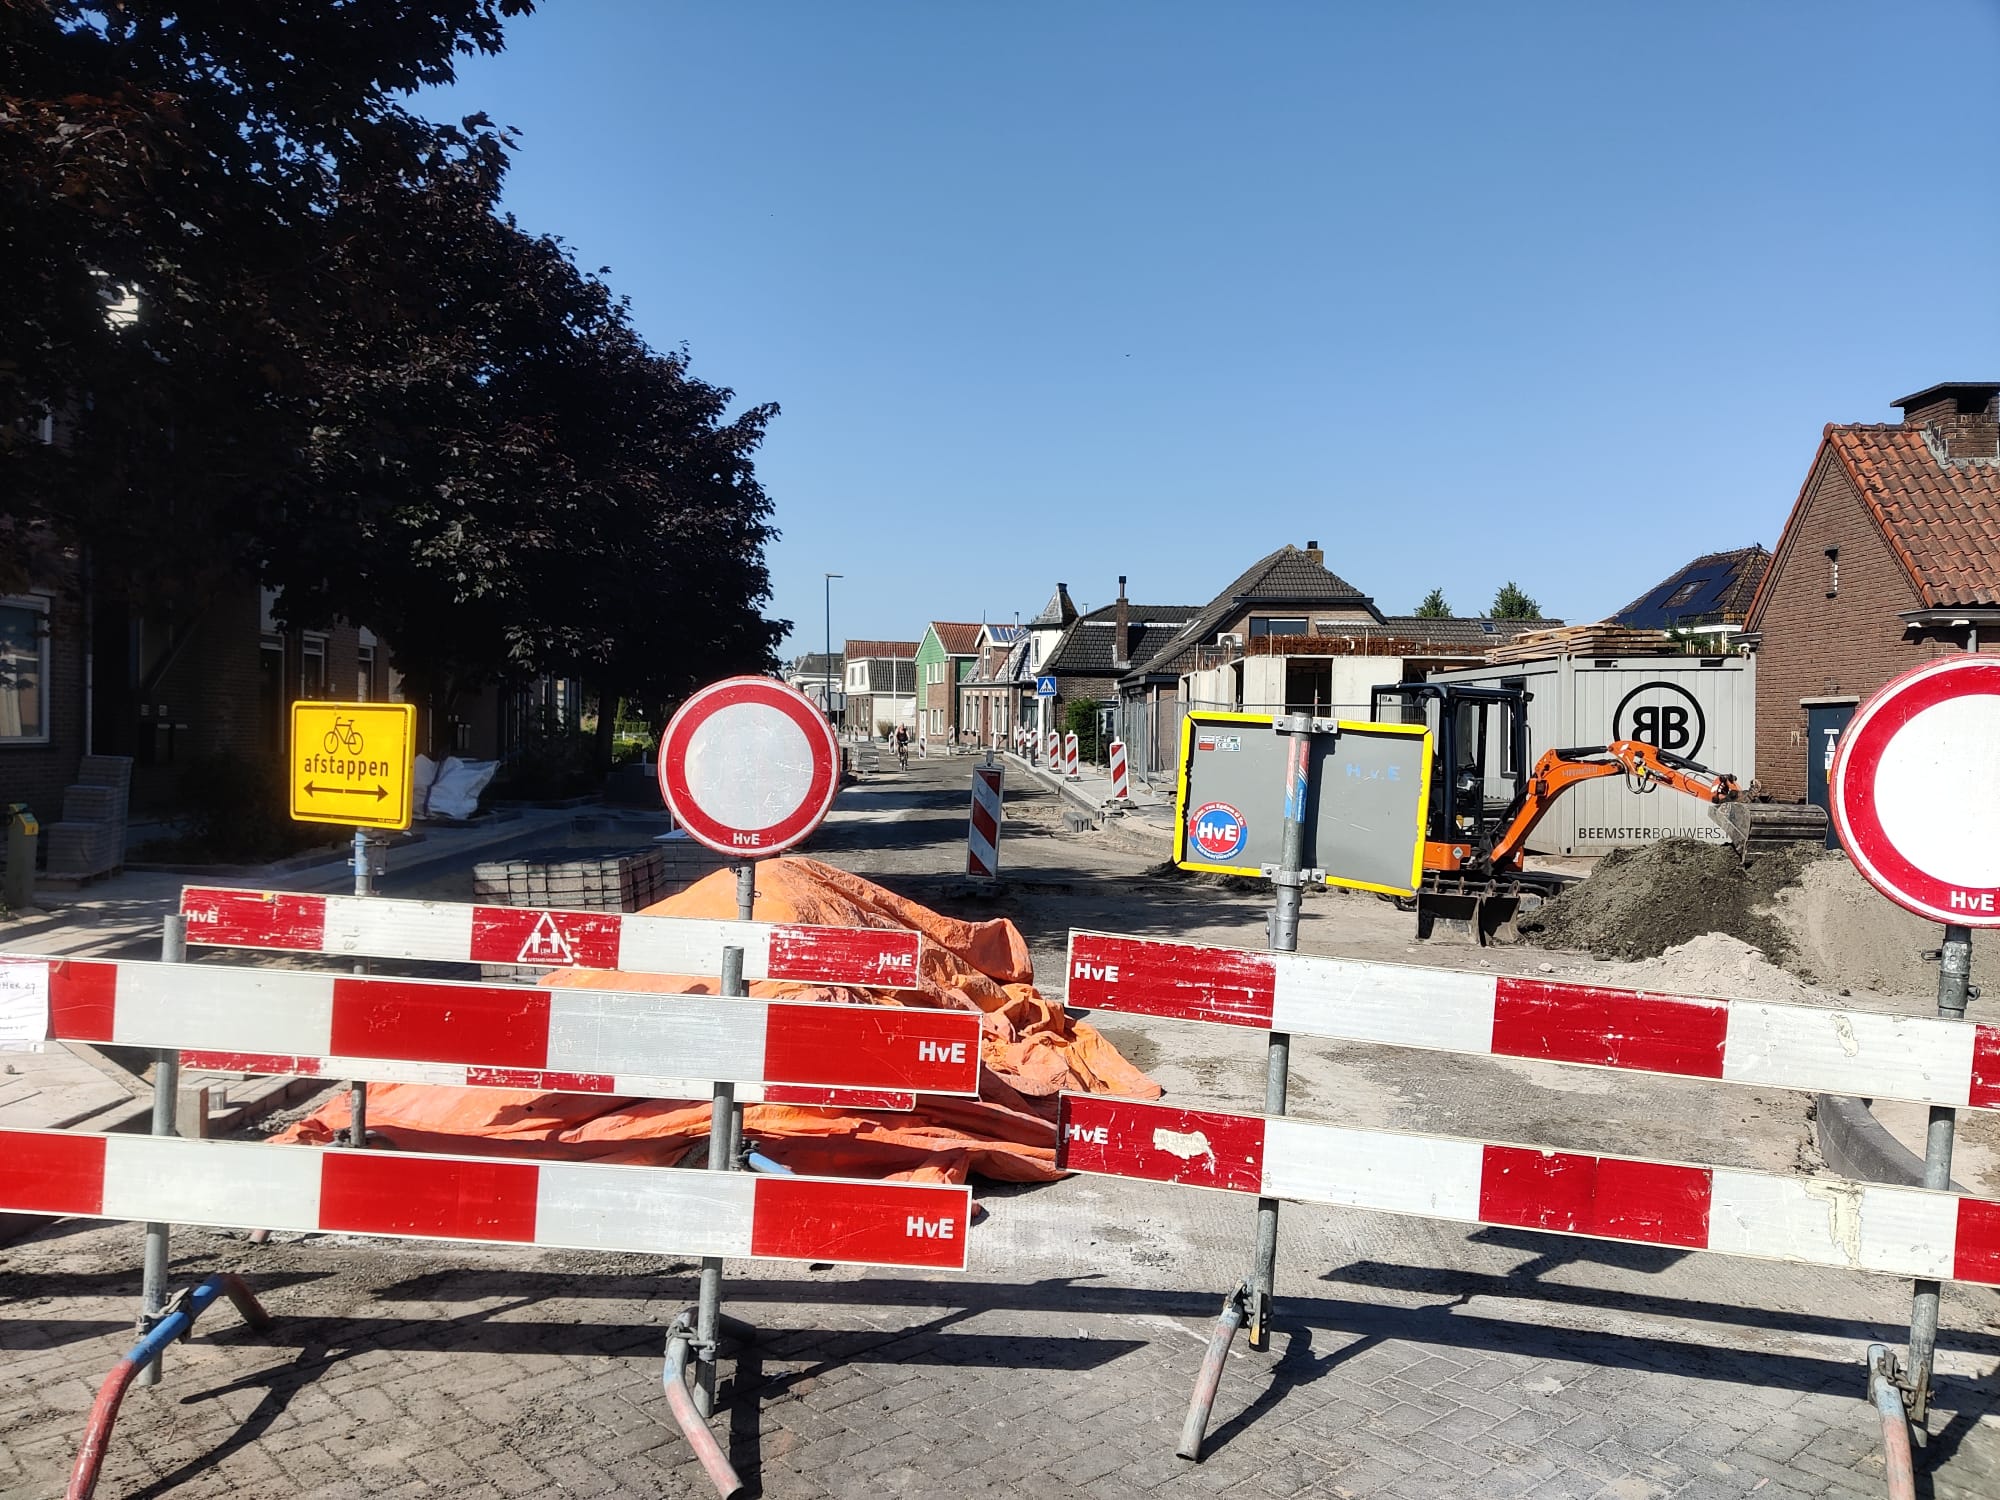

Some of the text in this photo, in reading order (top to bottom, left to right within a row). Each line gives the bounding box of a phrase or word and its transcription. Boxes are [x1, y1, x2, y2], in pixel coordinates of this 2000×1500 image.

[304, 753, 389, 781] afstappen
[733, 832, 760, 846] HvE
[1198, 821, 1237, 842] HvE
[1951, 890, 1995, 912] HvE
[186, 909, 218, 924] HvE
[879, 952, 912, 967] HvE
[1074, 962, 1120, 983] HvE
[918, 1040, 967, 1064] HvE
[1065, 1123, 1109, 1145] HvE
[906, 1215, 955, 1239] HvE
